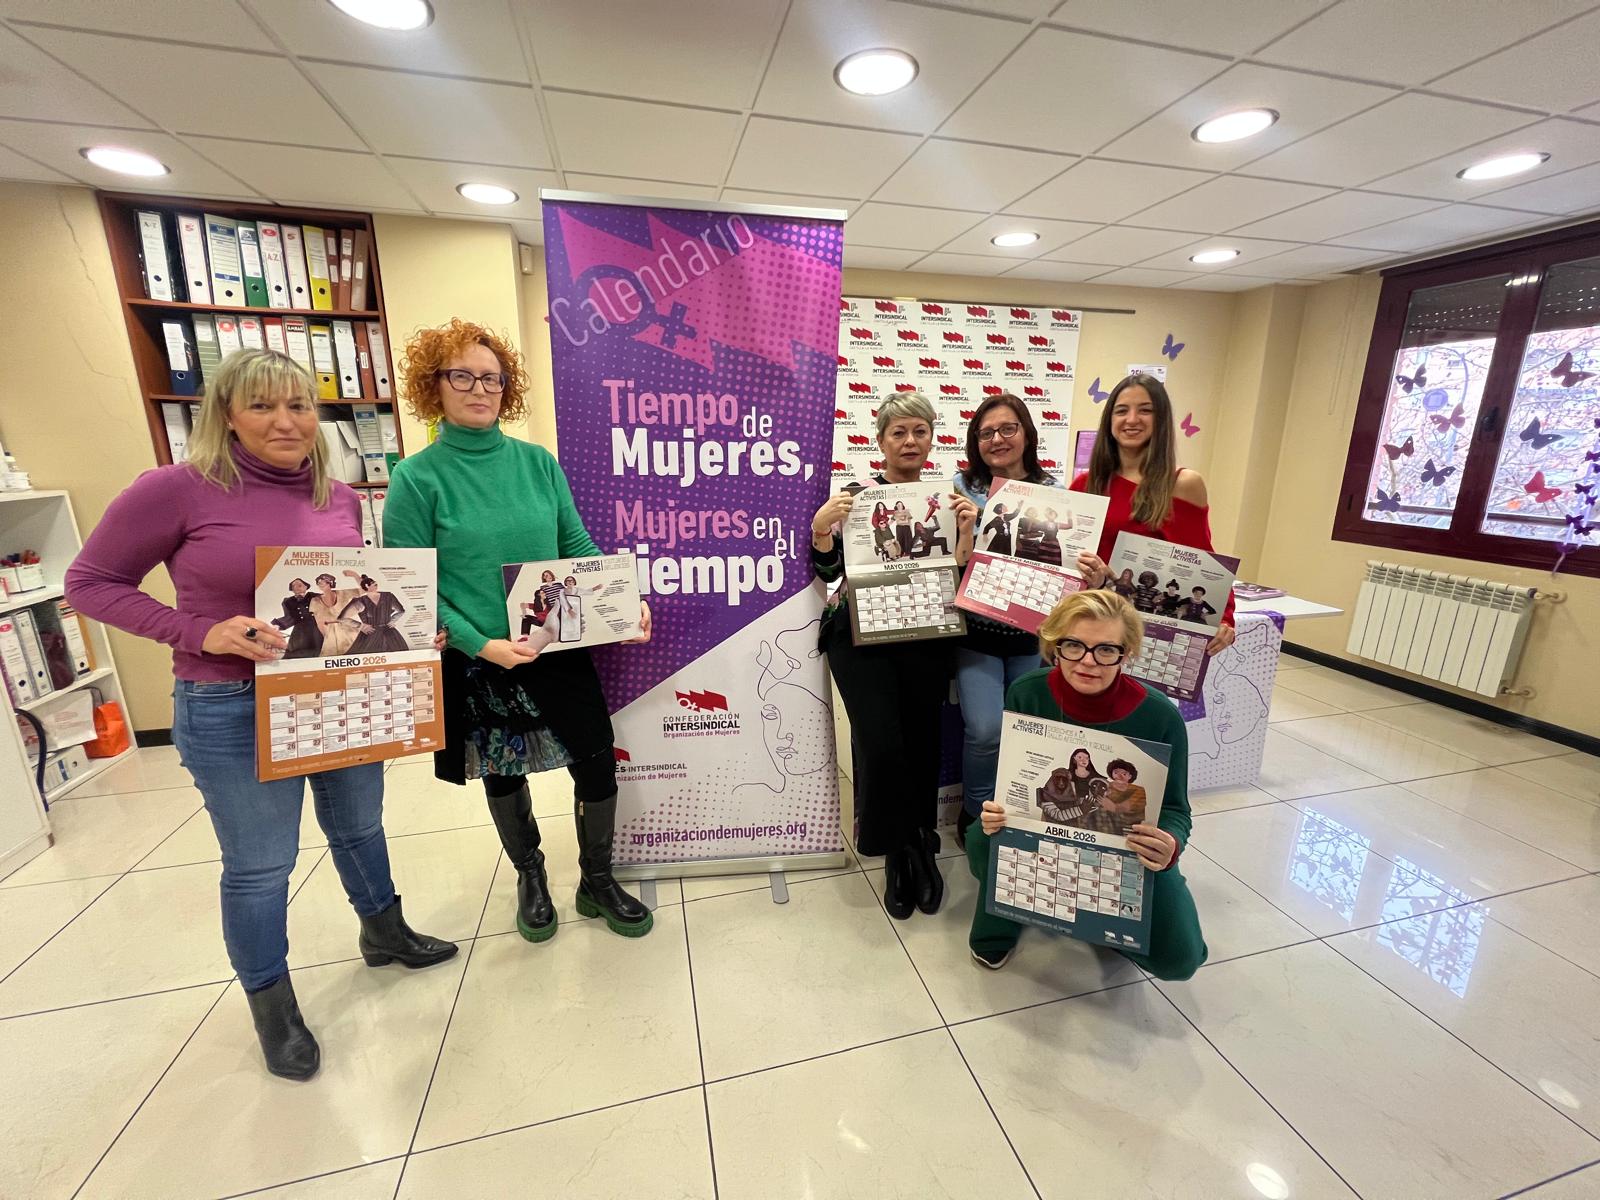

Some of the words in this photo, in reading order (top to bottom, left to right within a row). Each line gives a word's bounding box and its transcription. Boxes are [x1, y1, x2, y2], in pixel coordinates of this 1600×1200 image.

[551, 214, 753, 346] Calendario
[603, 380, 738, 435] Tiempo
[743, 407, 772, 437] de
[612, 428, 813, 487] Mujeres,
[616, 500, 748, 549] Mujeres
[754, 517, 781, 538] en
[775, 531, 796, 559] el
[618, 544, 784, 606] iempo
[325, 658, 360, 668] ENERO
[363, 656, 386, 665] 2026
[663, 712, 740, 722] CONFEDERACIÓN
[663, 720, 740, 731] INTERSINDICAL
[1012, 724, 1043, 735] ACTIVISTAS
[1018, 719, 1043, 729] MUJERES
[632, 822, 807, 847] organizaciondemujeres.org
[1045, 826, 1071, 838] ABRIL
[1074, 832, 1096, 843] 2026
